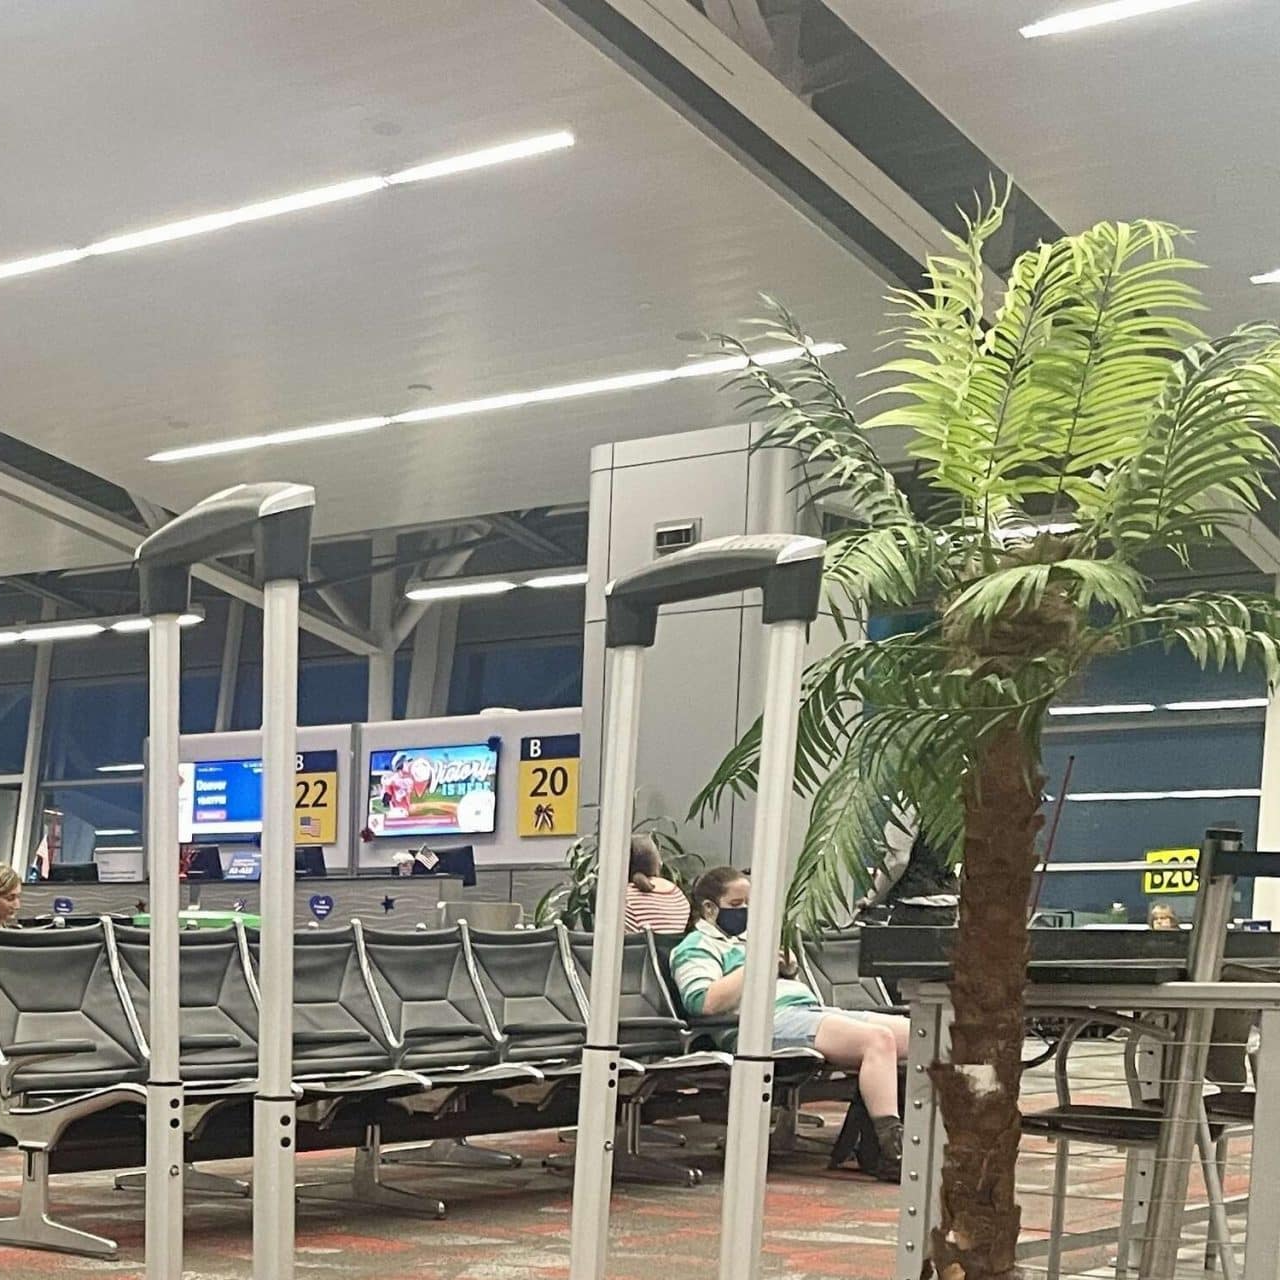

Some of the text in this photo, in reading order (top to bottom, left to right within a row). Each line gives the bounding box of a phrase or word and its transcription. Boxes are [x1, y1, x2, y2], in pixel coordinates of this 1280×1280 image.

[529, 739, 542, 758] B
[295, 754, 304, 771] B
[295, 779, 328, 809] 22
[530, 766, 569, 798] 20
